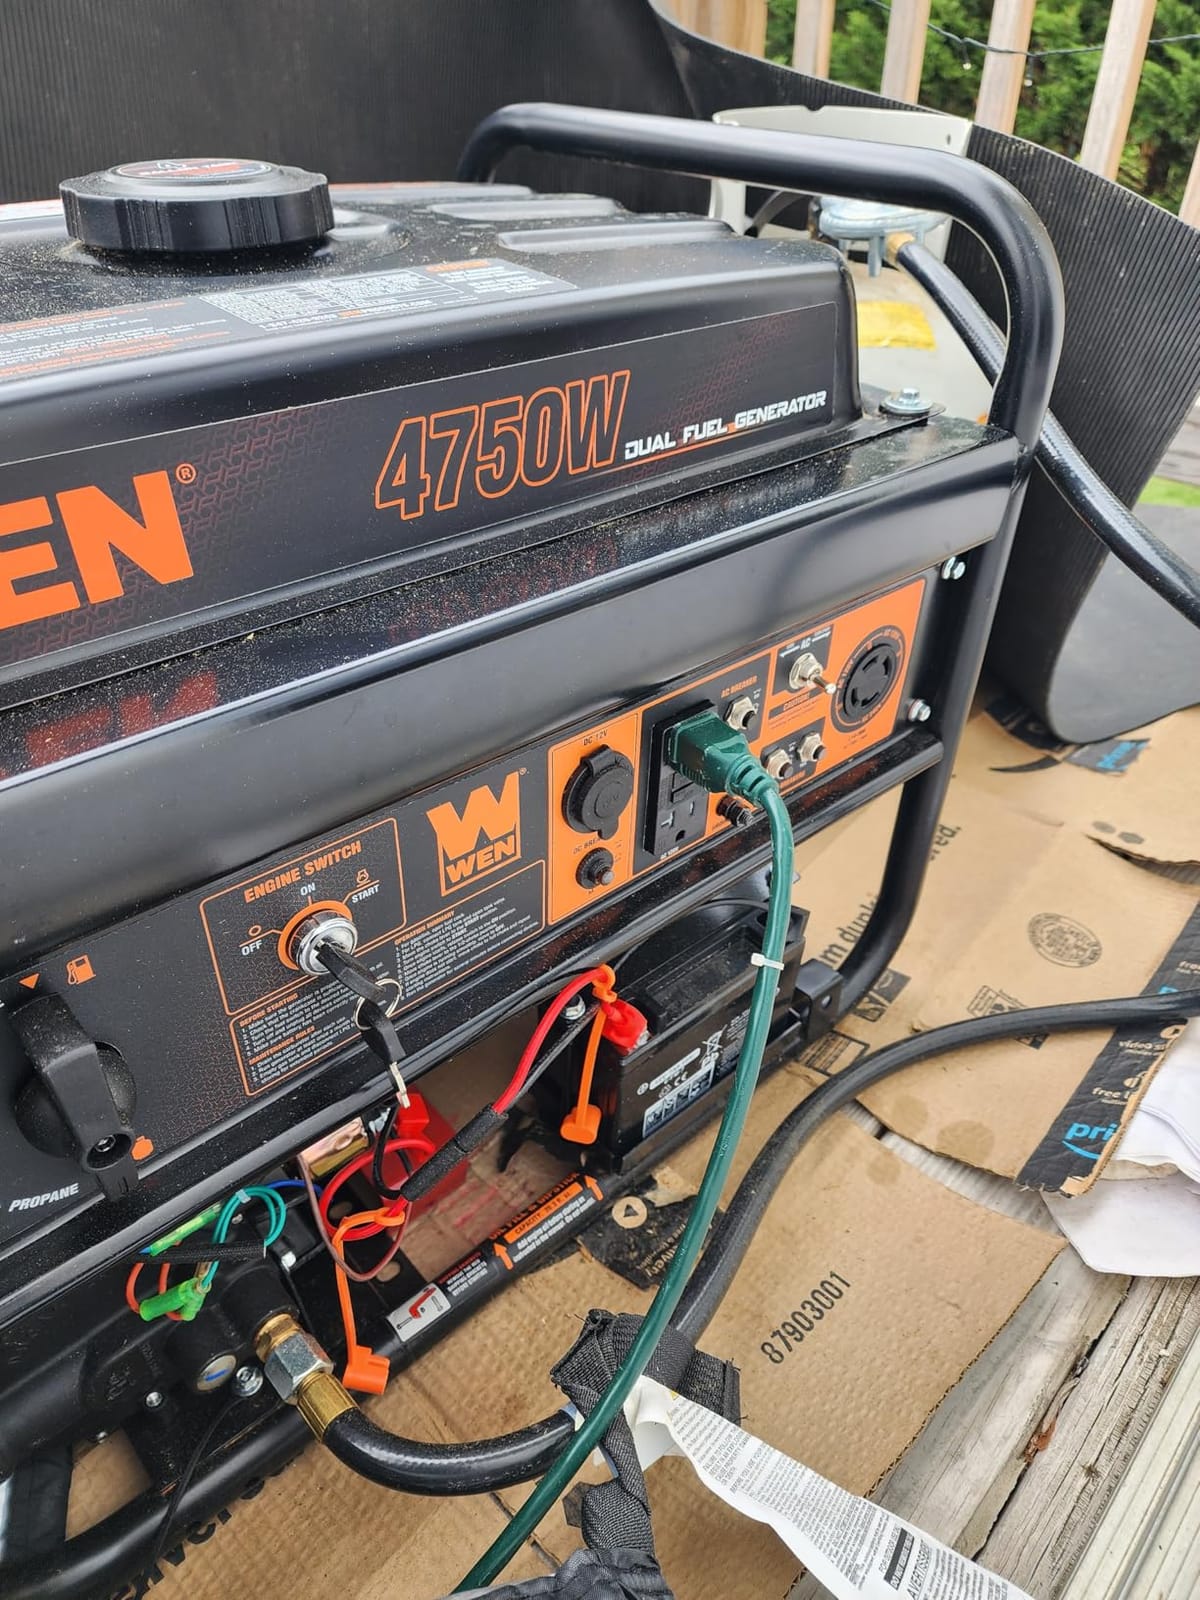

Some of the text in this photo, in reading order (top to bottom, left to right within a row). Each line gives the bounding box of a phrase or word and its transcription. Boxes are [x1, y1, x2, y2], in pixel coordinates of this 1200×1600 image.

[375, 369, 827, 520] 4750W DUAL FUEL GENERATOR
[0, 470, 194, 630] EN
[244, 840, 362, 904] ENGINE SWITCH
[446, 835, 516, 884] WEN
[300, 883, 316, 896] ON
[351, 884, 380, 903] START
[241, 940, 263, 956] OFF
[240, 992, 298, 1027] BEFORE STARTING
[1118, 1039, 1152, 1051] video
[1091, 1086, 1121, 1099] free
[1065, 1122, 1121, 1141] pri
[8, 1183, 79, 1212] PROPANE
[760, 1270, 851, 1364] 87903001
